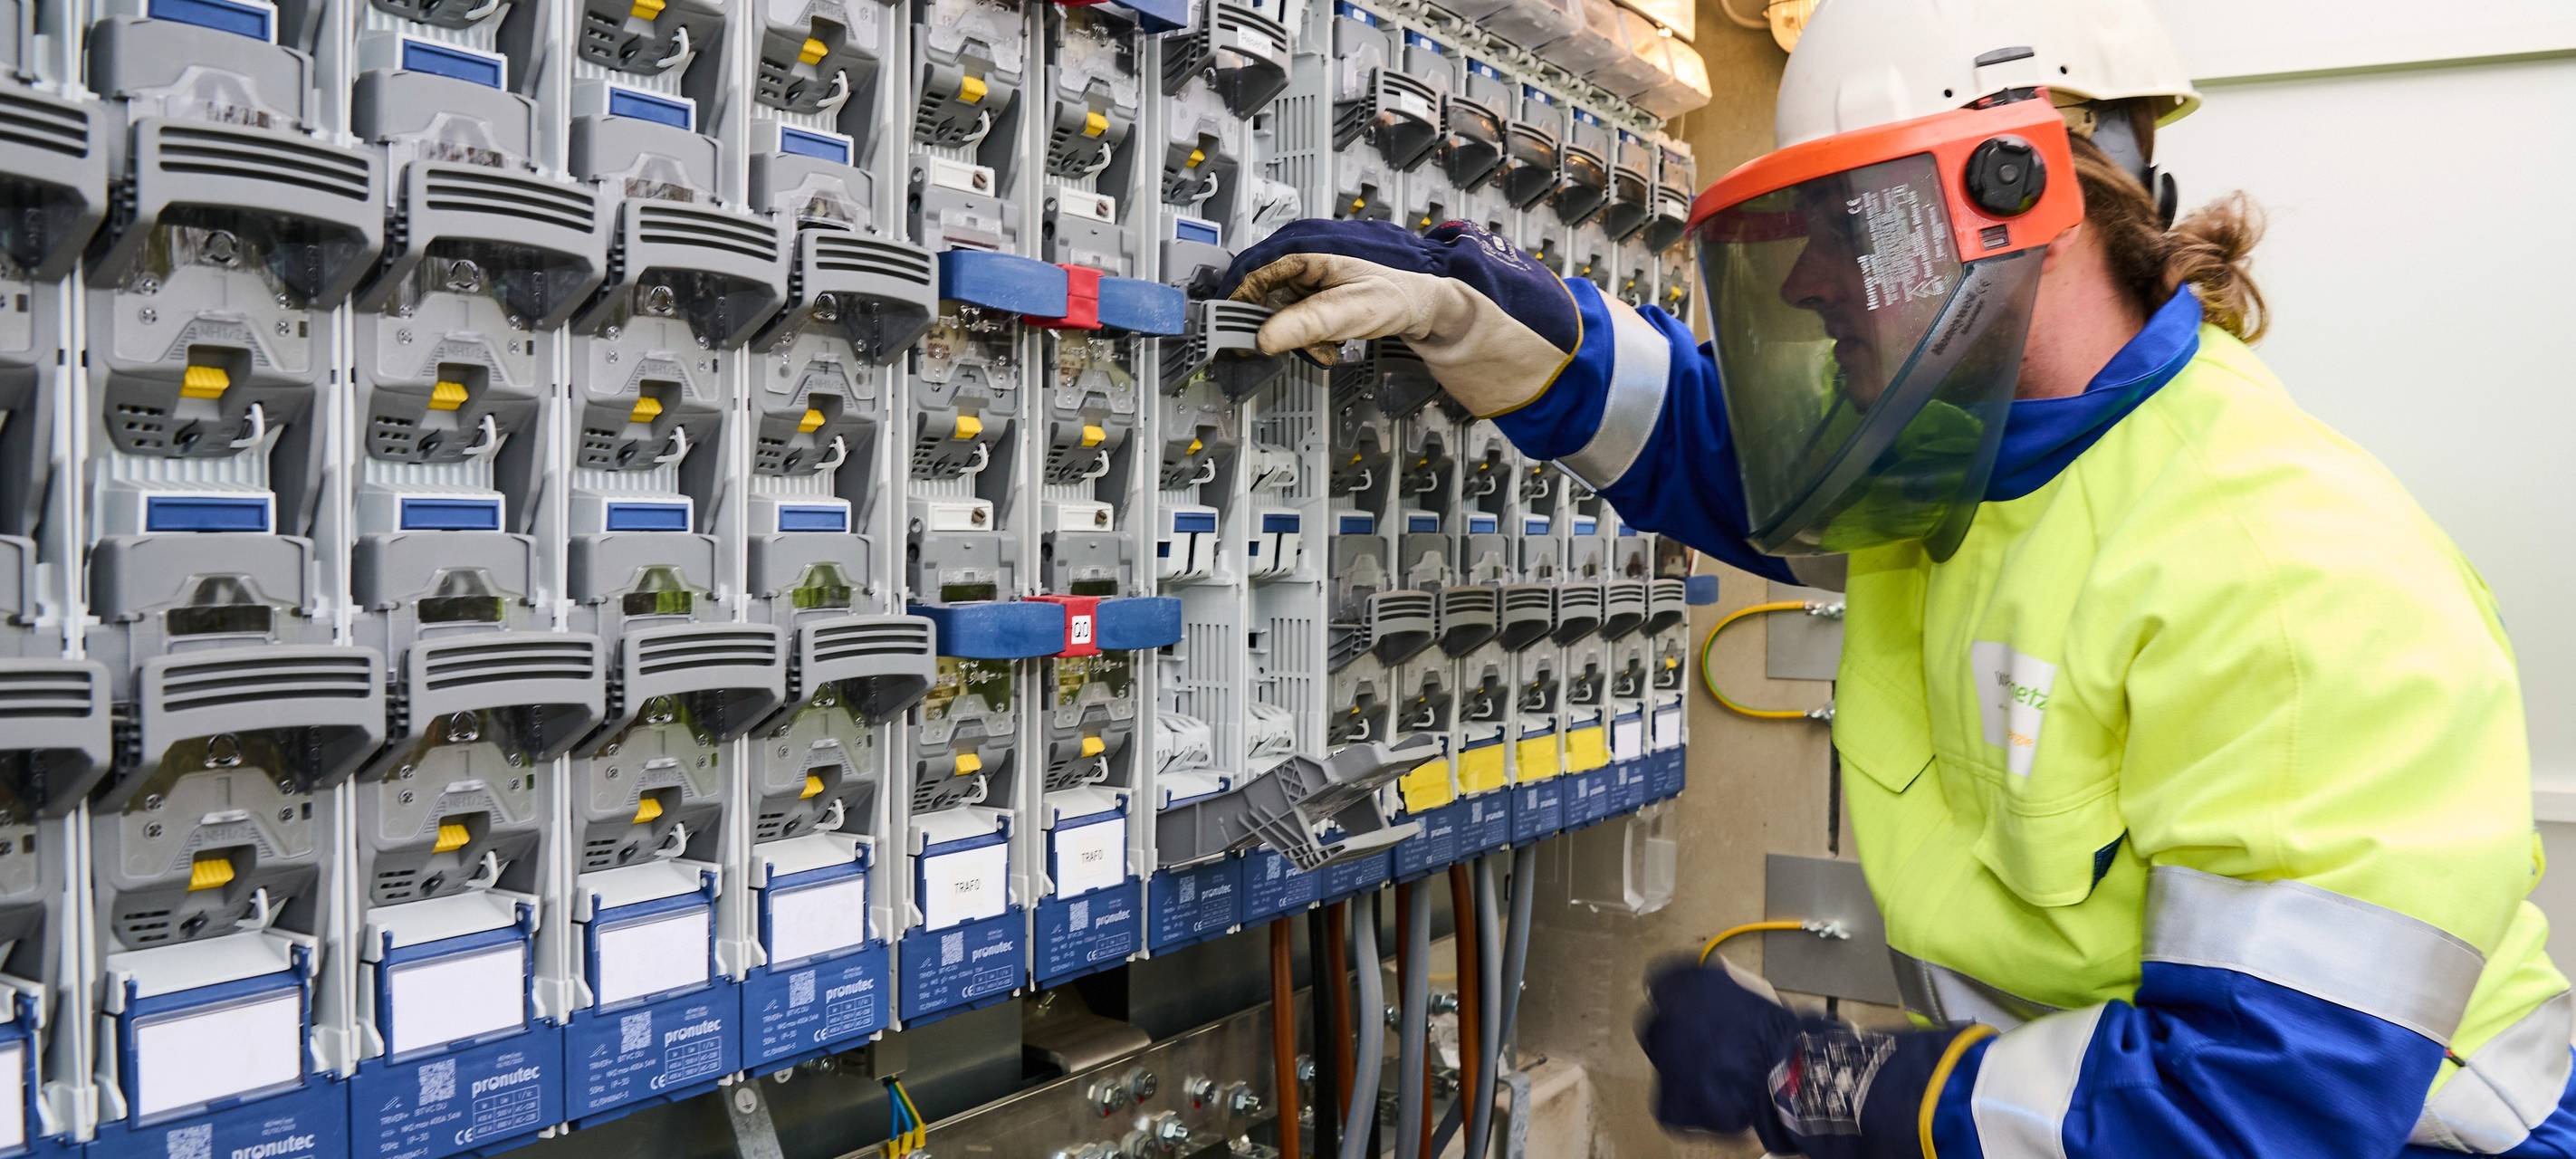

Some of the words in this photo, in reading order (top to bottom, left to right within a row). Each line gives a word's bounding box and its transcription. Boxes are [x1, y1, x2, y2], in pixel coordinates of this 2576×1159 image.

[1857, 254, 1881, 311] Honeywell
[1080, 849, 1102, 865] TRAFO
[954, 878, 979, 893] TRAFO
[1201, 883, 1232, 902] pronutec
[1278, 896, 1288, 908] CE
[1096, 909, 1130, 930] pronutec
[1193, 920, 1203, 933] CE
[972, 941, 1013, 963] pronutec
[1087, 949, 1097, 962] CE
[826, 978, 874, 1004] pronutec
[962, 984, 973, 998] CE
[665, 1019, 722, 1048] pronutec
[814, 1028, 828, 1042] CE
[472, 1066, 541, 1098] pronutec
[650, 1074, 666, 1090] CE
[455, 1126, 474, 1145] CE
[231, 1133, 315, 1159] pronutec
